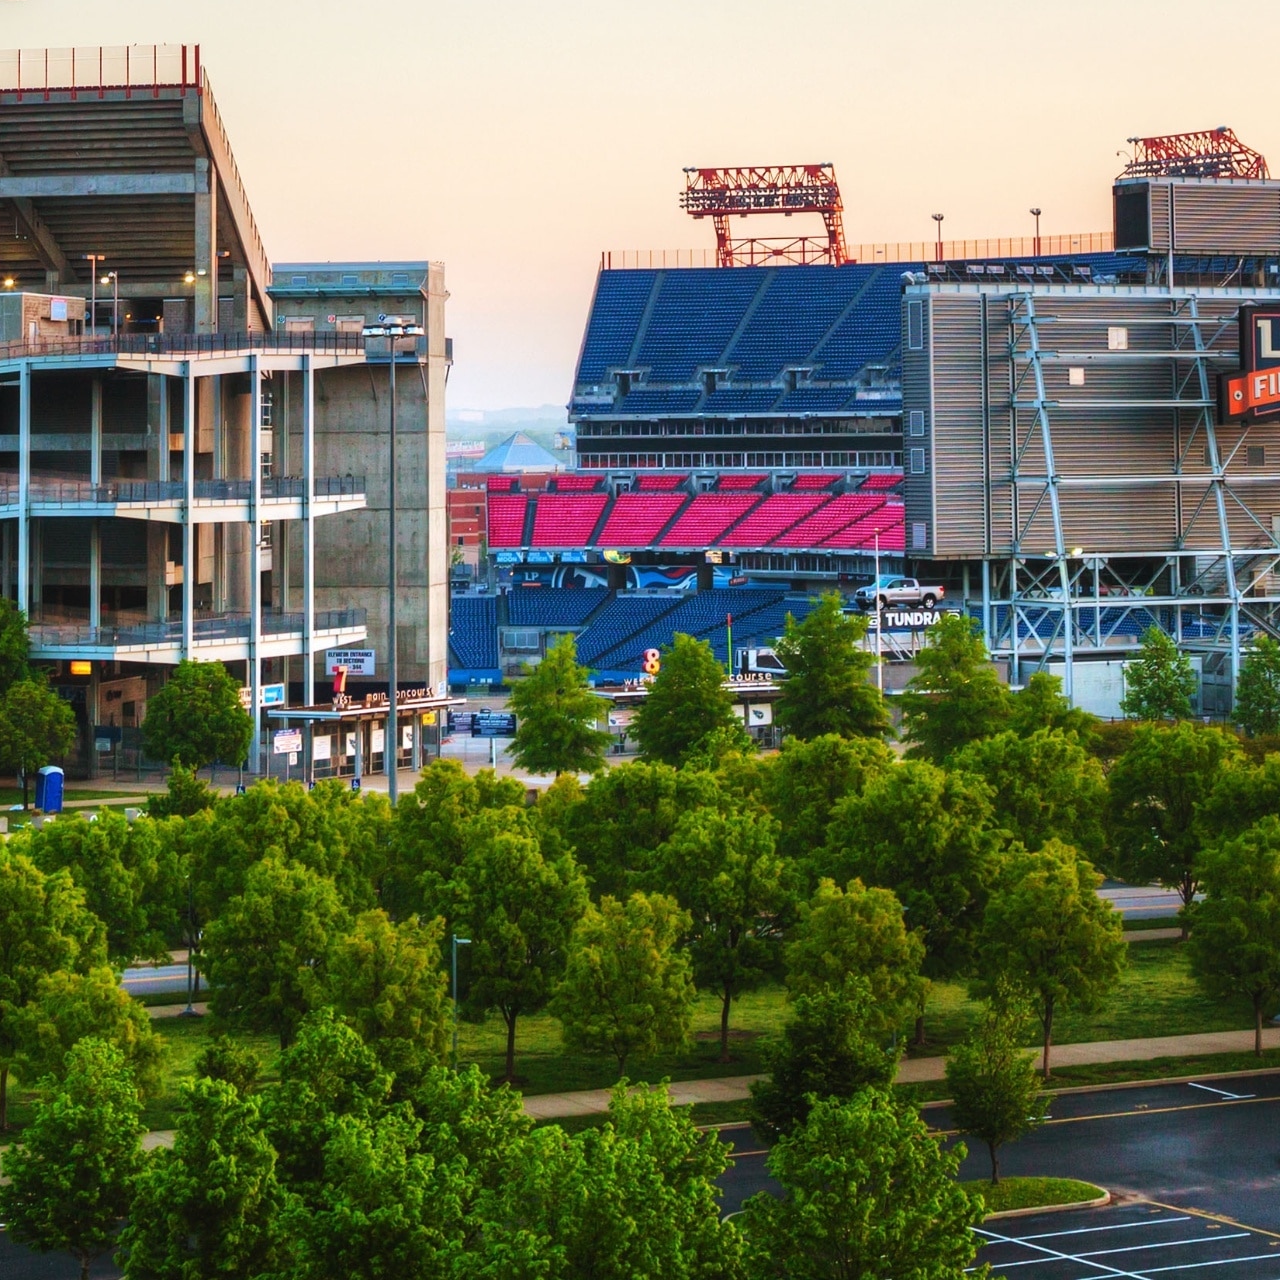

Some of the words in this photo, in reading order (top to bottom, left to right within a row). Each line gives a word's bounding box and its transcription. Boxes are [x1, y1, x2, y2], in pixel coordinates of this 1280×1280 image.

[524, 572, 539, 581] LP
[885, 611, 941, 627] TUNDRA
[642, 648, 661, 675] 8
[331, 665, 348, 693] 7
[729, 672, 772, 682] course
[332, 695, 353, 705] WEST
[396, 687, 434, 699] oncours
